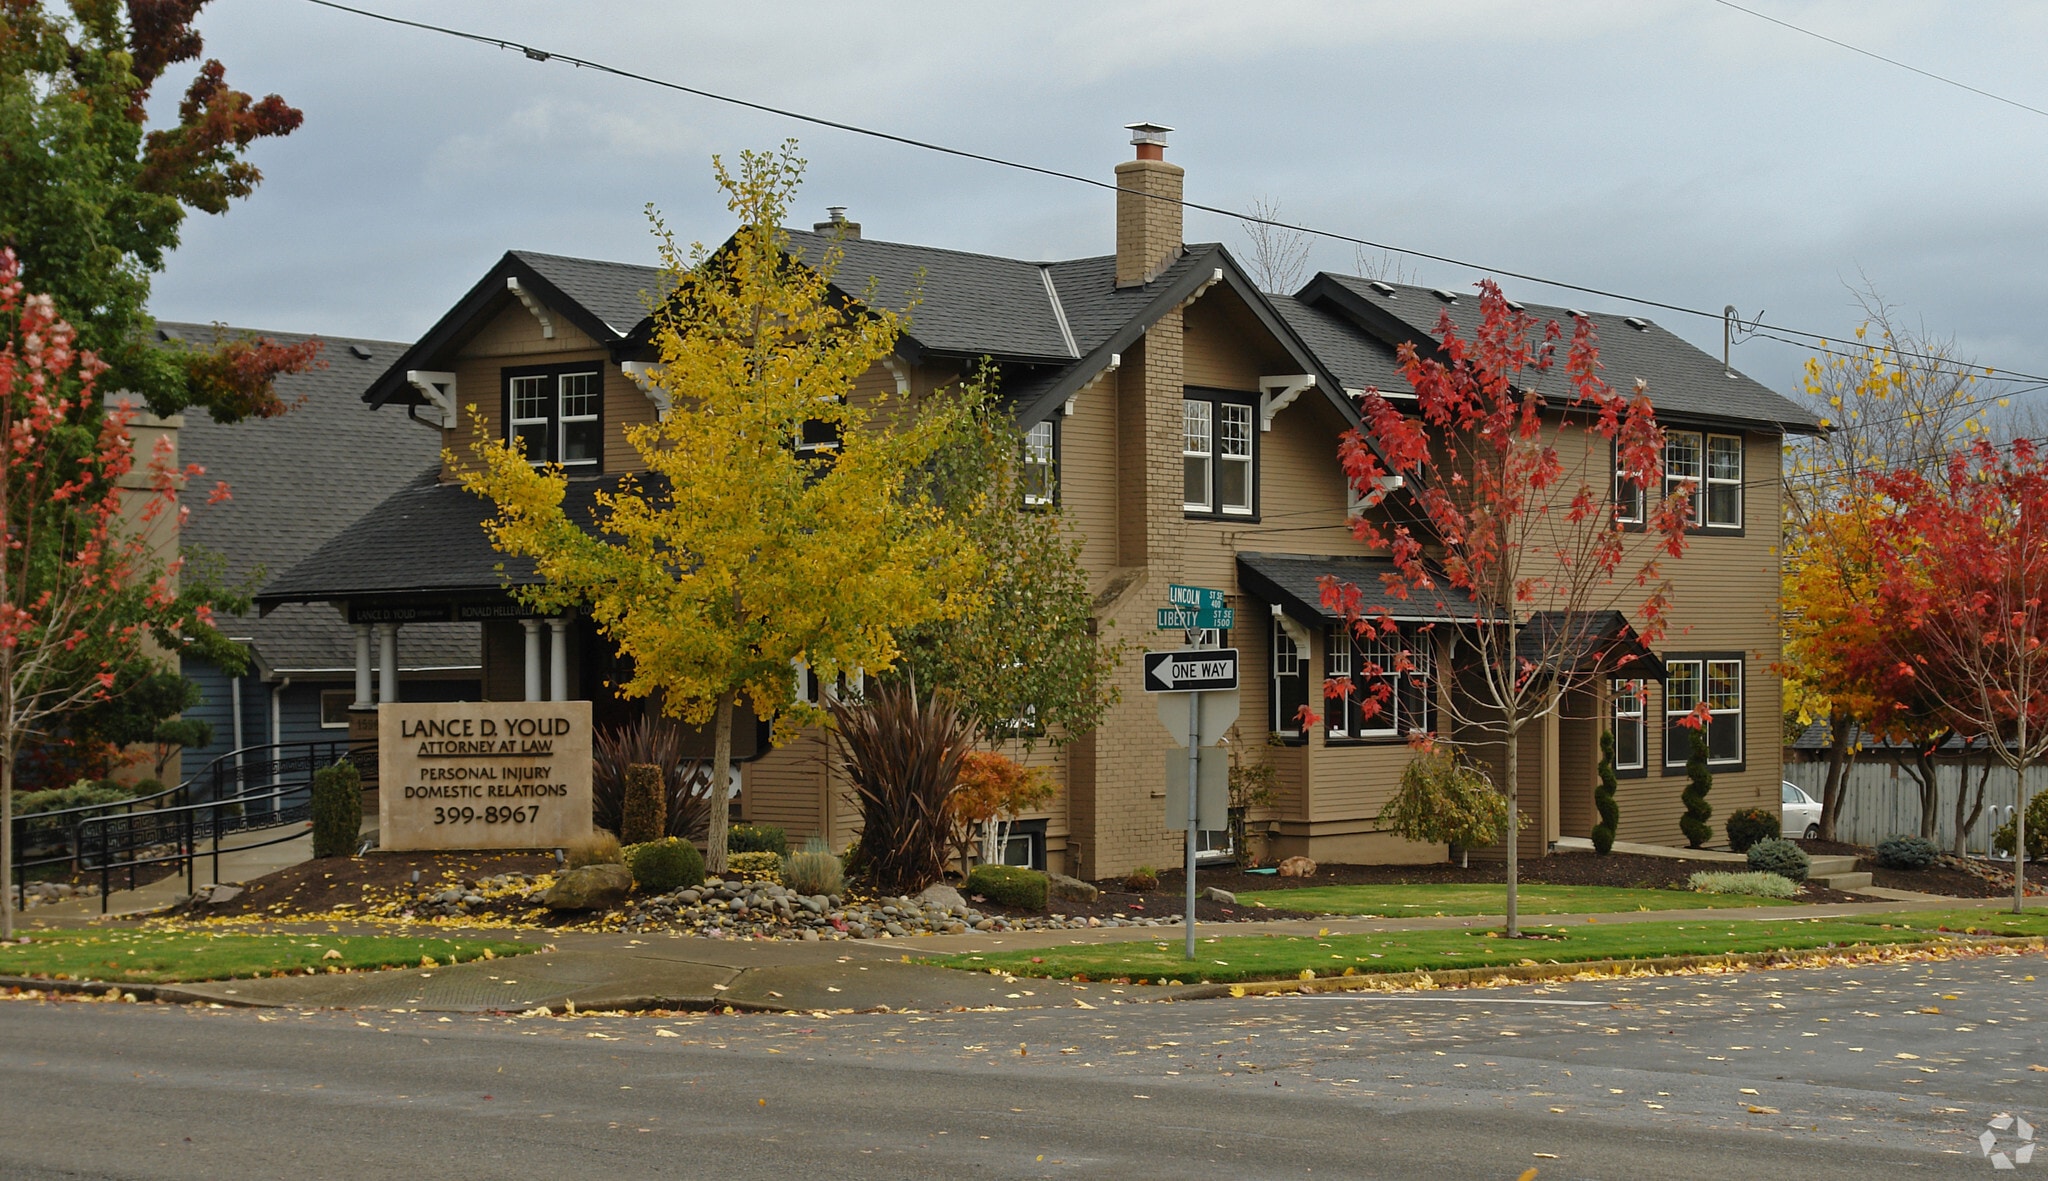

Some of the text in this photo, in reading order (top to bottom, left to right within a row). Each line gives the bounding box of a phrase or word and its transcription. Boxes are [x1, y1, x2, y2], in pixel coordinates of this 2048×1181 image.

[1170, 587, 1200, 605] LINCOLN
[1209, 591, 1223, 600] ST SE
[1211, 600, 1221, 608] 400
[393, 609, 416, 619] YOUD
[461, 607, 491, 617] RONALD
[1158, 611, 1198, 626] LIBERTY
[1213, 610, 1232, 619] ST SE
[1213, 619, 1230, 627] 1500
[1172, 662, 1227, 678] ONE WAY
[401, 718, 570, 738] LANCE D. YOUD
[418, 740, 553, 754] ATTORNEY AT LAW
[420, 767, 552, 782] PERSONAL INJURY
[404, 784, 567, 799] DOMESTIC RELATIONS
[434, 805, 540, 825] 399-8967
